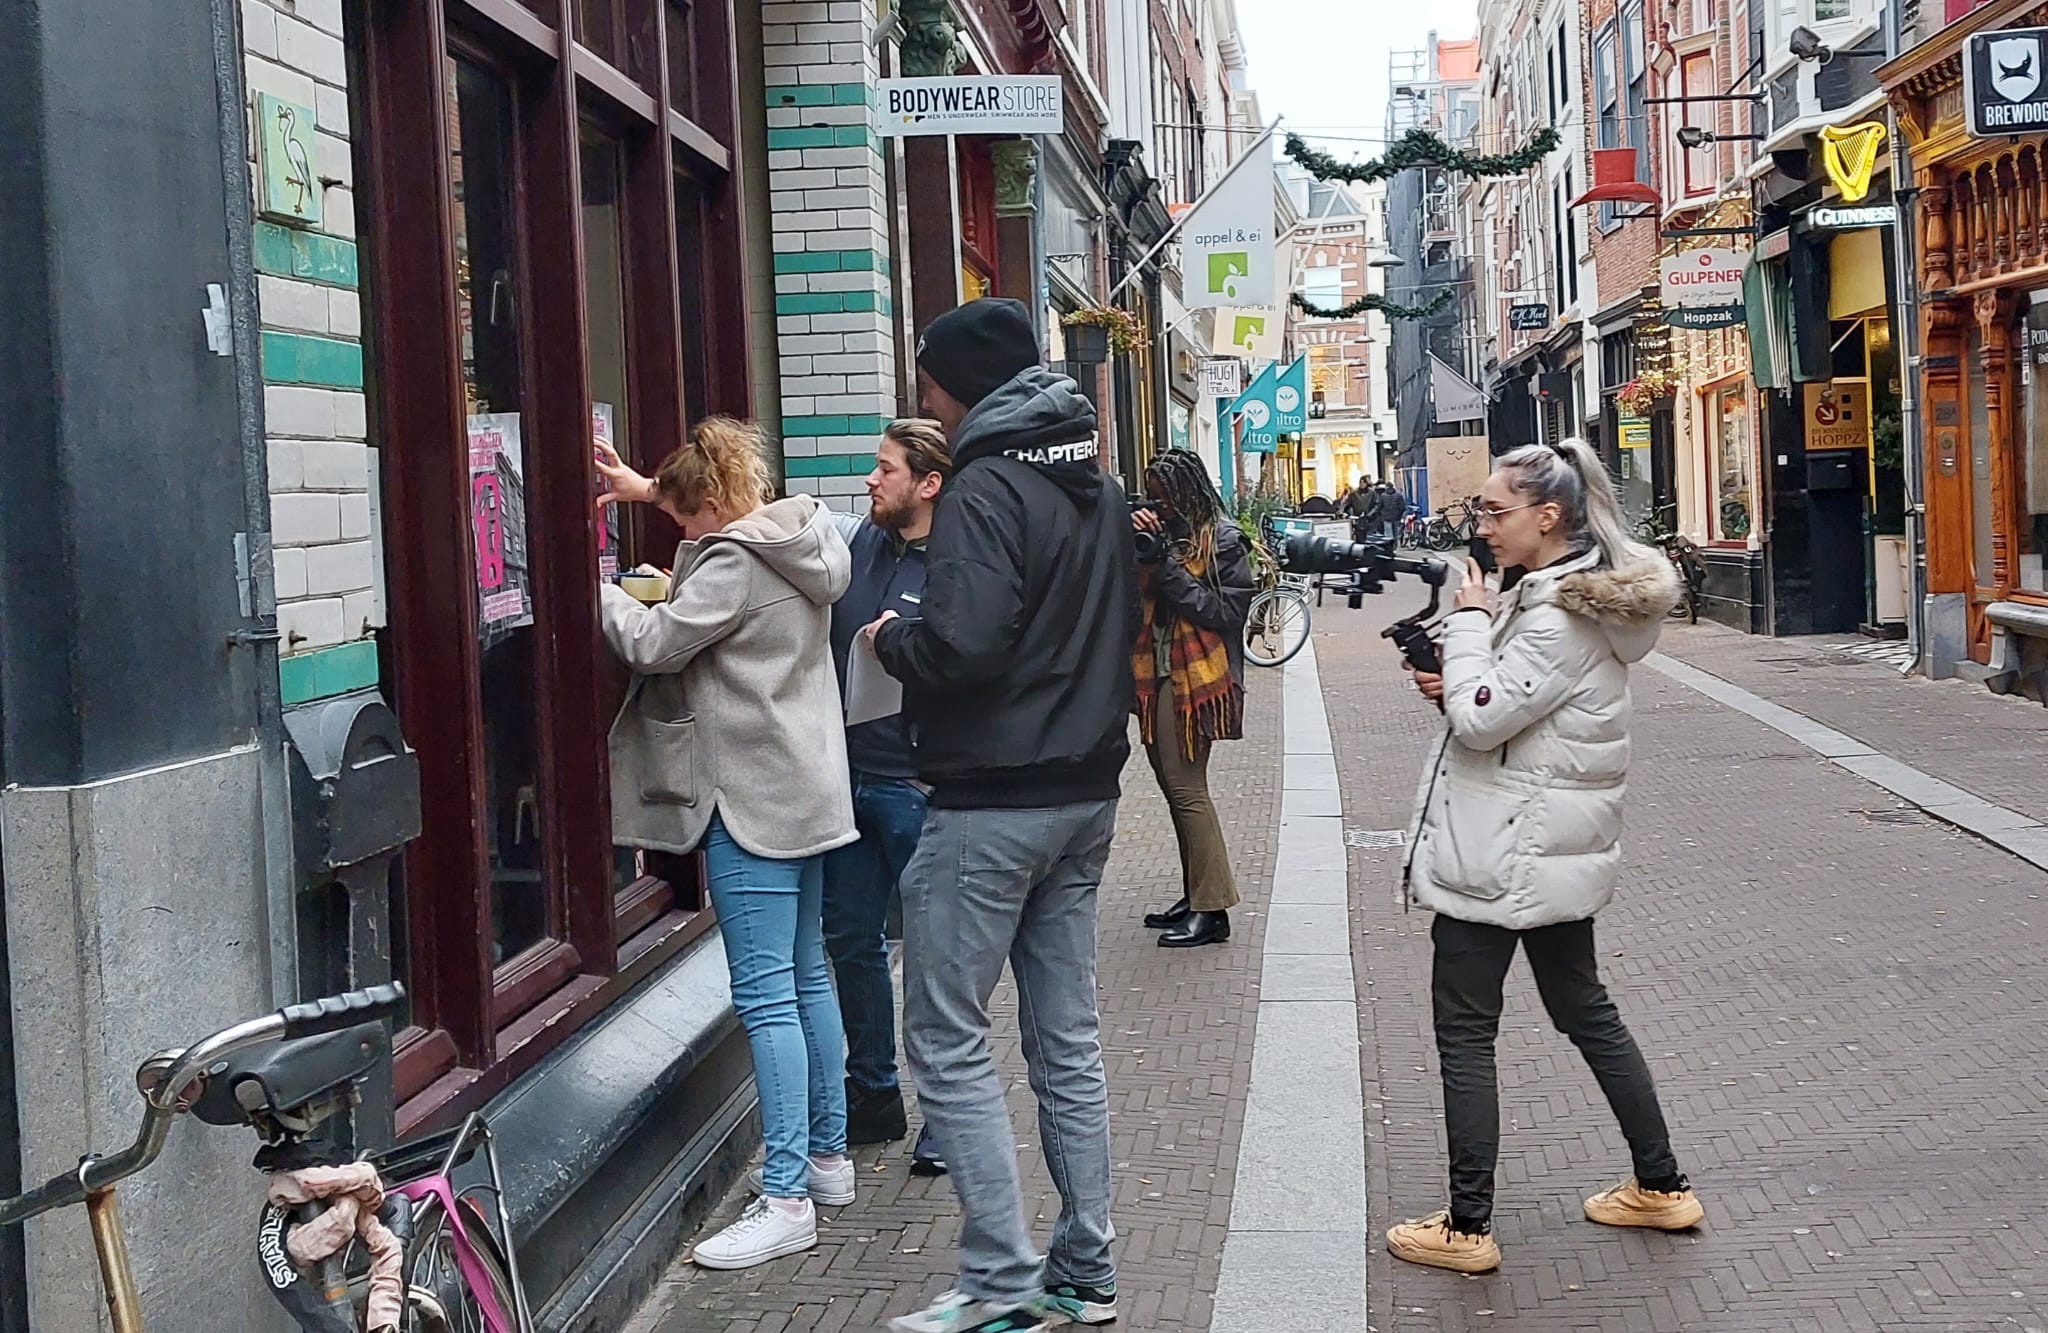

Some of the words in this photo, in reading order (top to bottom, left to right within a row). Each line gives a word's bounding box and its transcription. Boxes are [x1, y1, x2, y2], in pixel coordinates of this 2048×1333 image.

[1815, 206, 1896, 225] GUINNESS
[1195, 228, 1231, 248] appel
[1236, 229, 1246, 242] &
[1249, 228, 1261, 241] ei
[1668, 269, 1742, 285] GULPENER
[1683, 310, 1733, 324] Hoppzak
